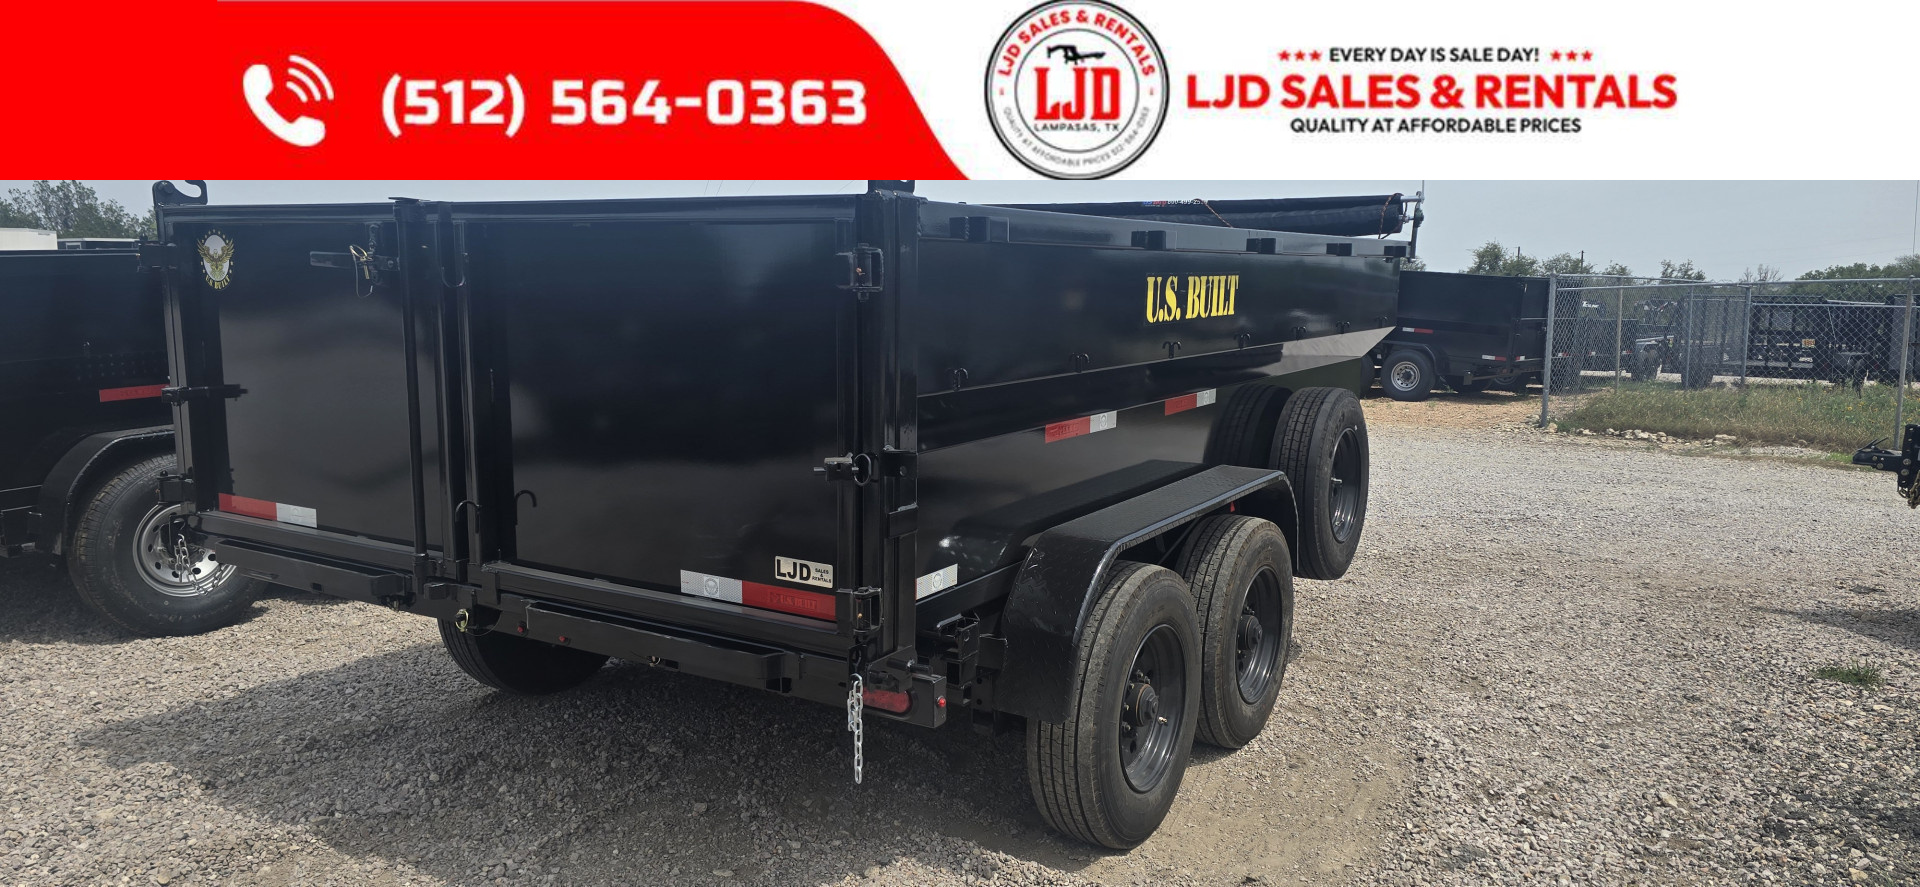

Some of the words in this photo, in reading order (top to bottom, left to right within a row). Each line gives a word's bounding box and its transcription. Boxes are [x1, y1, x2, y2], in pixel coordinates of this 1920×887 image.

[1146, 275, 1181, 323] U.S.
[1185, 275, 1239, 319] BUILT
[776, 558, 811, 581] LJD
